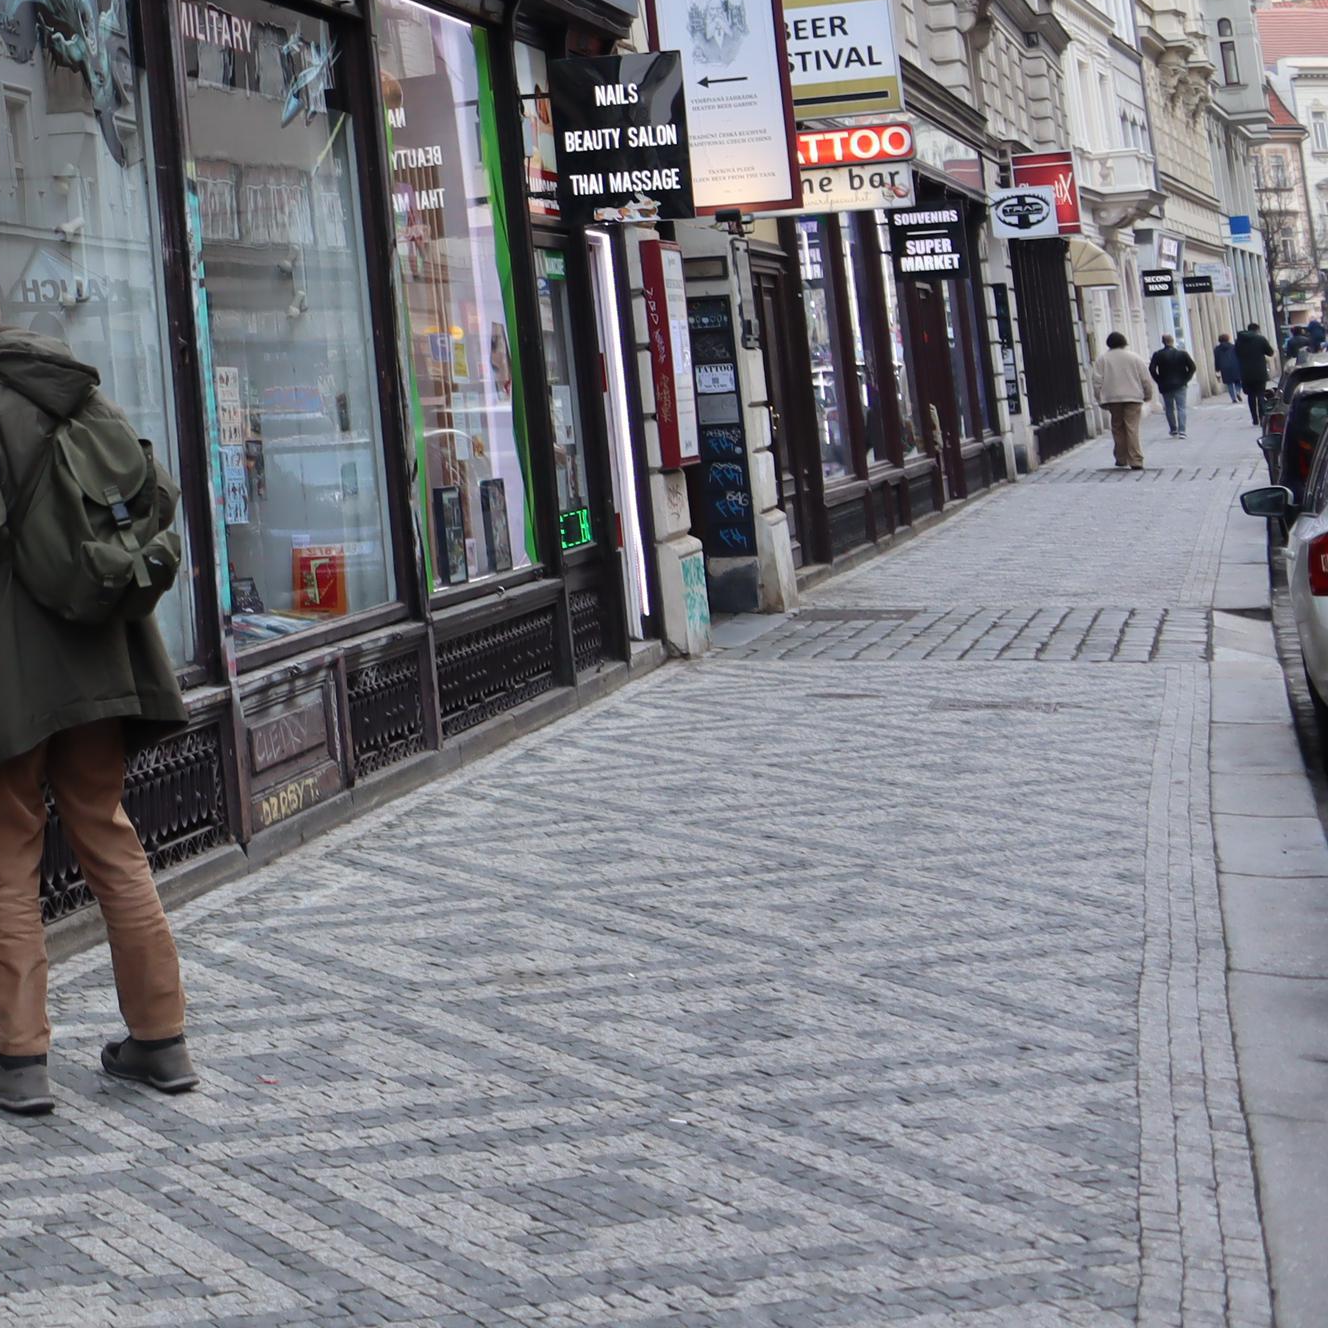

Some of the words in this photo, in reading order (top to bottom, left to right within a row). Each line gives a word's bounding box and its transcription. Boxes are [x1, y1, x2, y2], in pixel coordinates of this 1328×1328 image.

[180, 1, 252, 54] MILITARY
[594, 82, 639, 108] NAILS
[565, 126, 621, 153] BEAUTY
[627, 123, 678, 149] SALON
[569, 174, 605, 197] THAI
[608, 167, 681, 194] MASSAGE
[848, 168, 900, 191] bar
[893, 210, 958, 226] SOUVENIRS
[906, 238, 952, 256] SUPER
[900, 253, 960, 273] MARKET
[1144, 274, 1172, 284] SECOND
[1148, 283, 1169, 292] HAND
[697, 364, 734, 374] TATTOO
